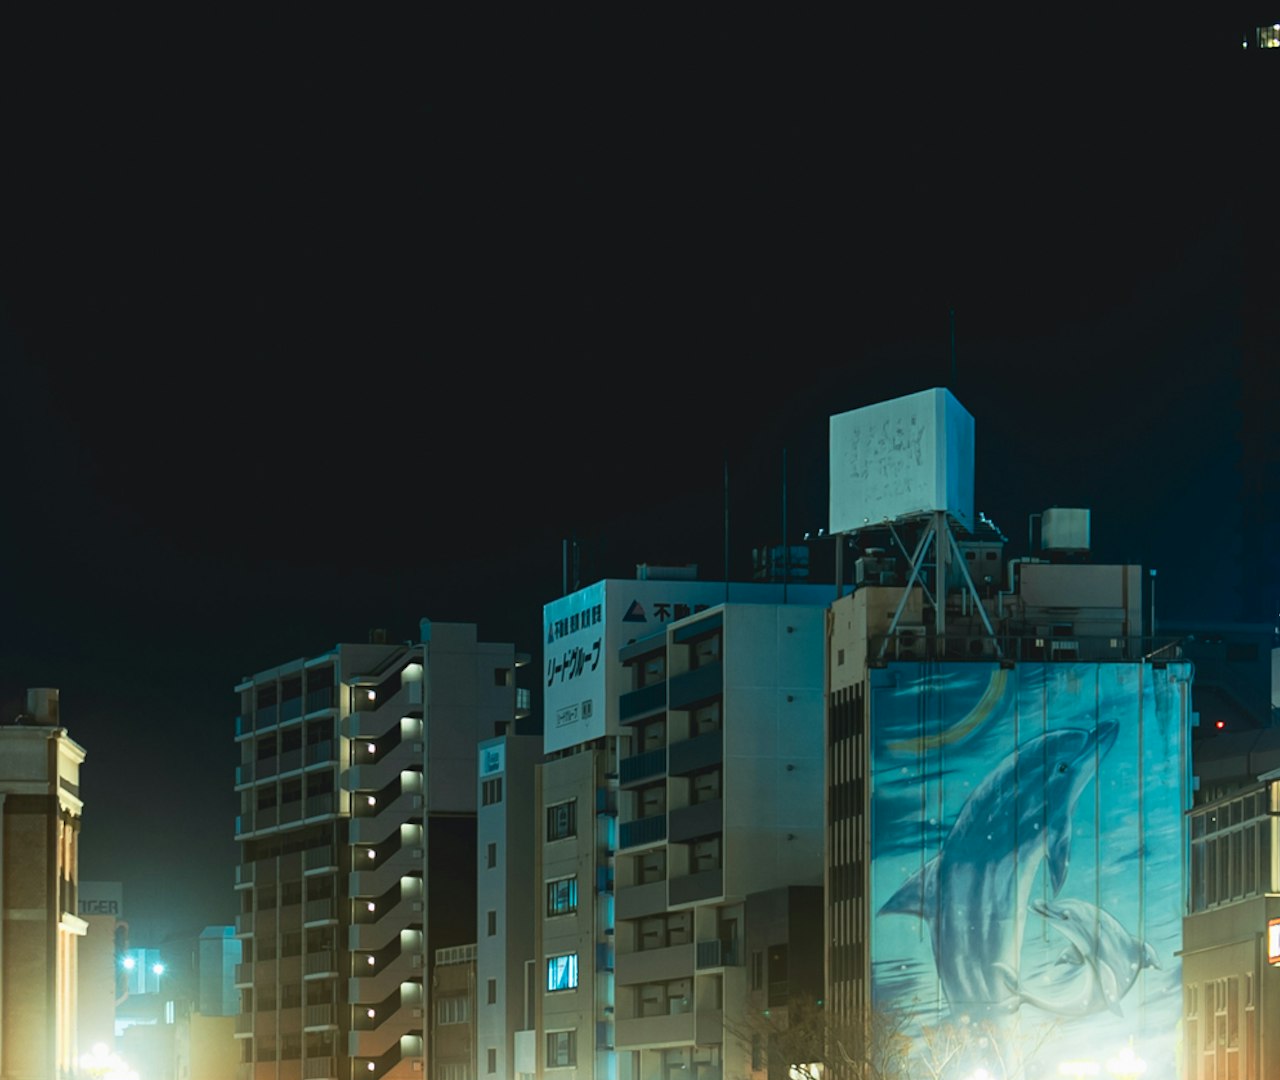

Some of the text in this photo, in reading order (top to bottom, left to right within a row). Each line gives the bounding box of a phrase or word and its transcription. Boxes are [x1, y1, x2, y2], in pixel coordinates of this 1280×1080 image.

[547, 636, 602, 688] リードグループ
